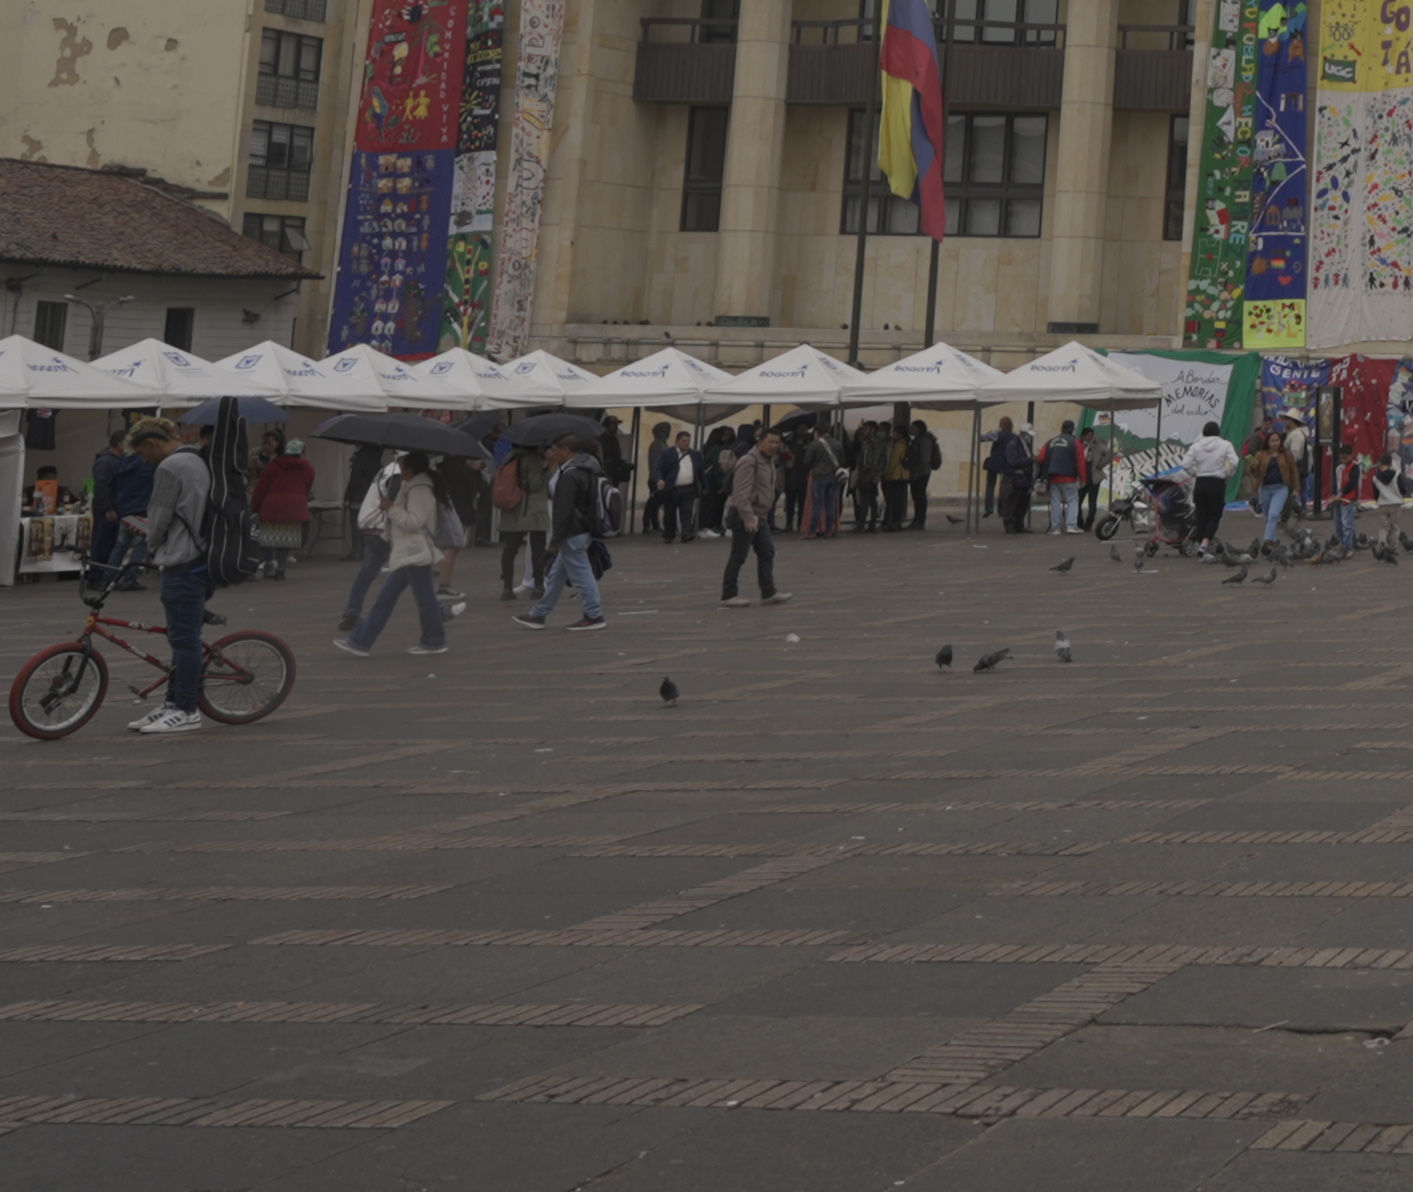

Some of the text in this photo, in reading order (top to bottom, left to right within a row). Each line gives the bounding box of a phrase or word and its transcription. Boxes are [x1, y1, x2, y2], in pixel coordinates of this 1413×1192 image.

[439, 6, 457, 98] COMUNIDAD
[440, 105, 449, 143] VIVA
[1164, 386, 1220, 409] MEMORIAS
